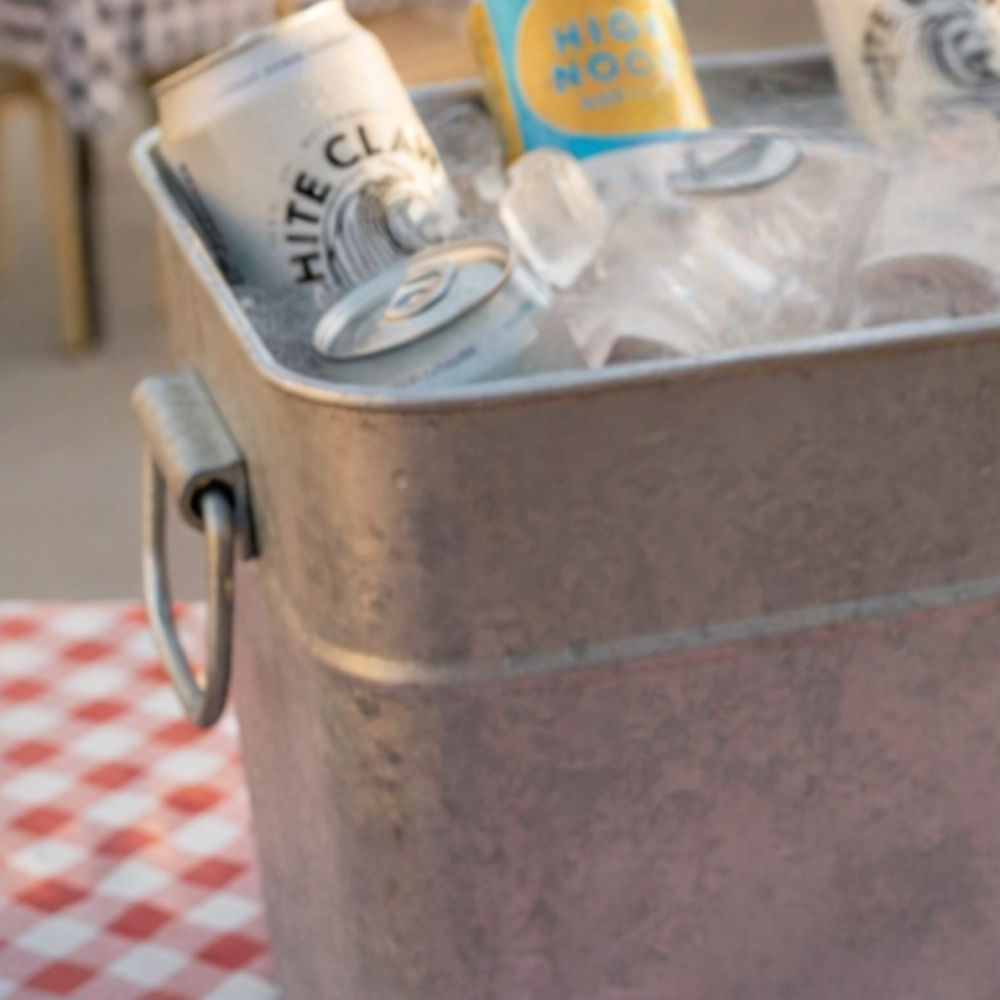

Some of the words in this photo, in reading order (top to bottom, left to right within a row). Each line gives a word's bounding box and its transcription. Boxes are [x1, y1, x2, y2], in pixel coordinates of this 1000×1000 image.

[554, 8, 663, 54] HIG
[554, 47, 677, 93] NOO
[286, 172, 331, 285] HITE
